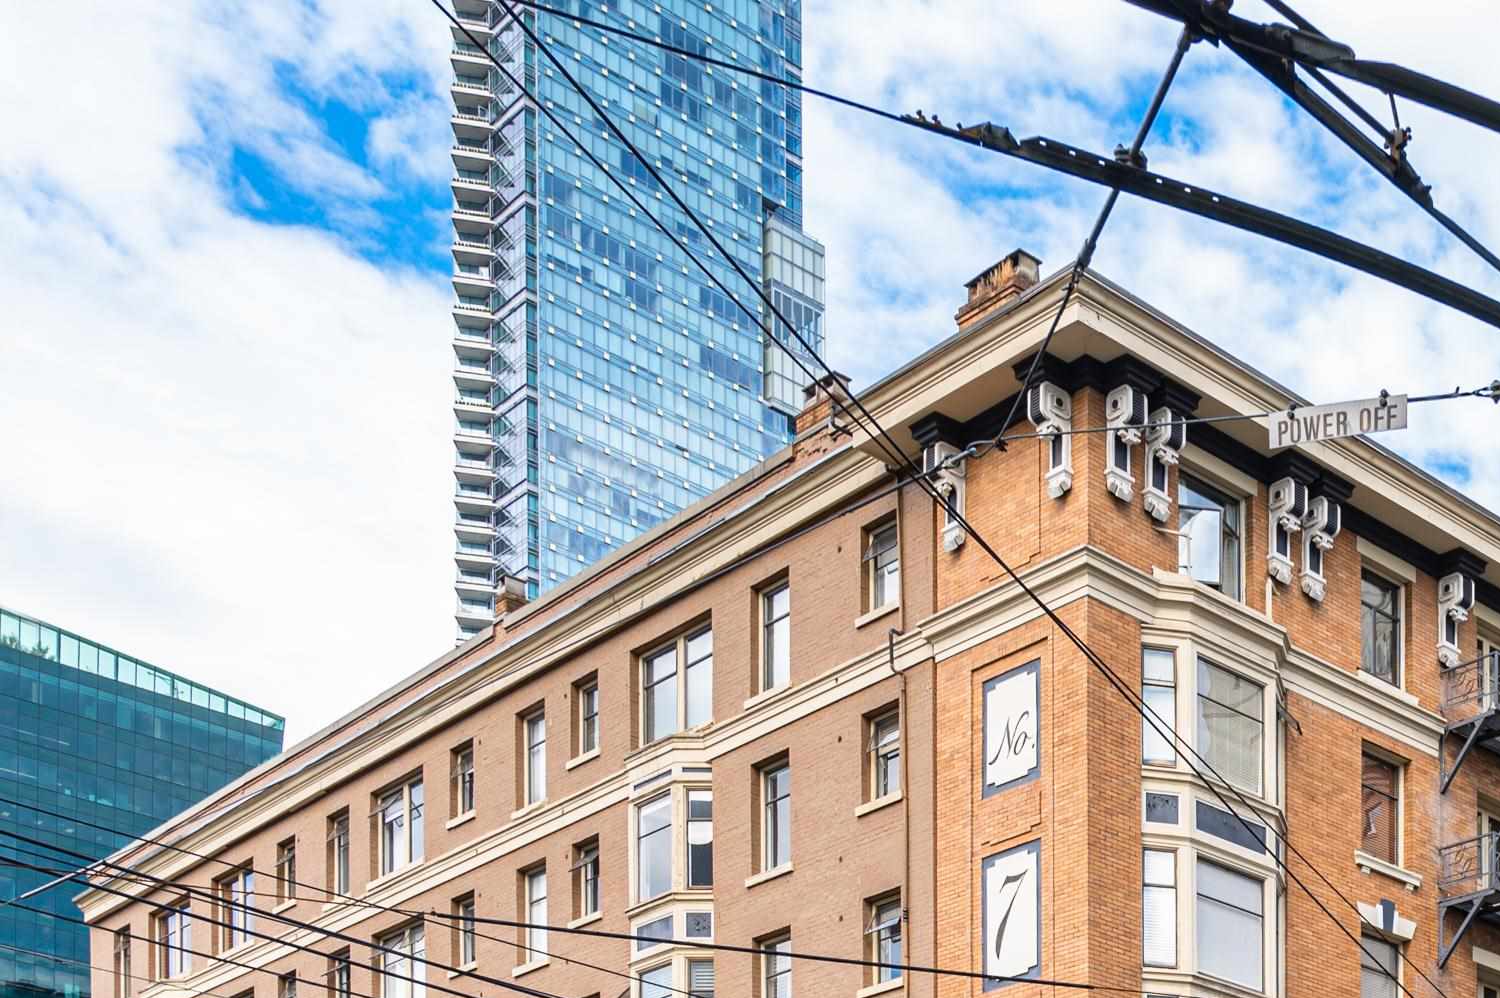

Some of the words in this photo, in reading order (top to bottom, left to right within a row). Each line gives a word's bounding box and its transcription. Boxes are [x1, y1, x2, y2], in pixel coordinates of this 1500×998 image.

[1278, 411, 1348, 446] POWER
[1359, 404, 1398, 433] OFF
[995, 869, 1028, 961] 7
